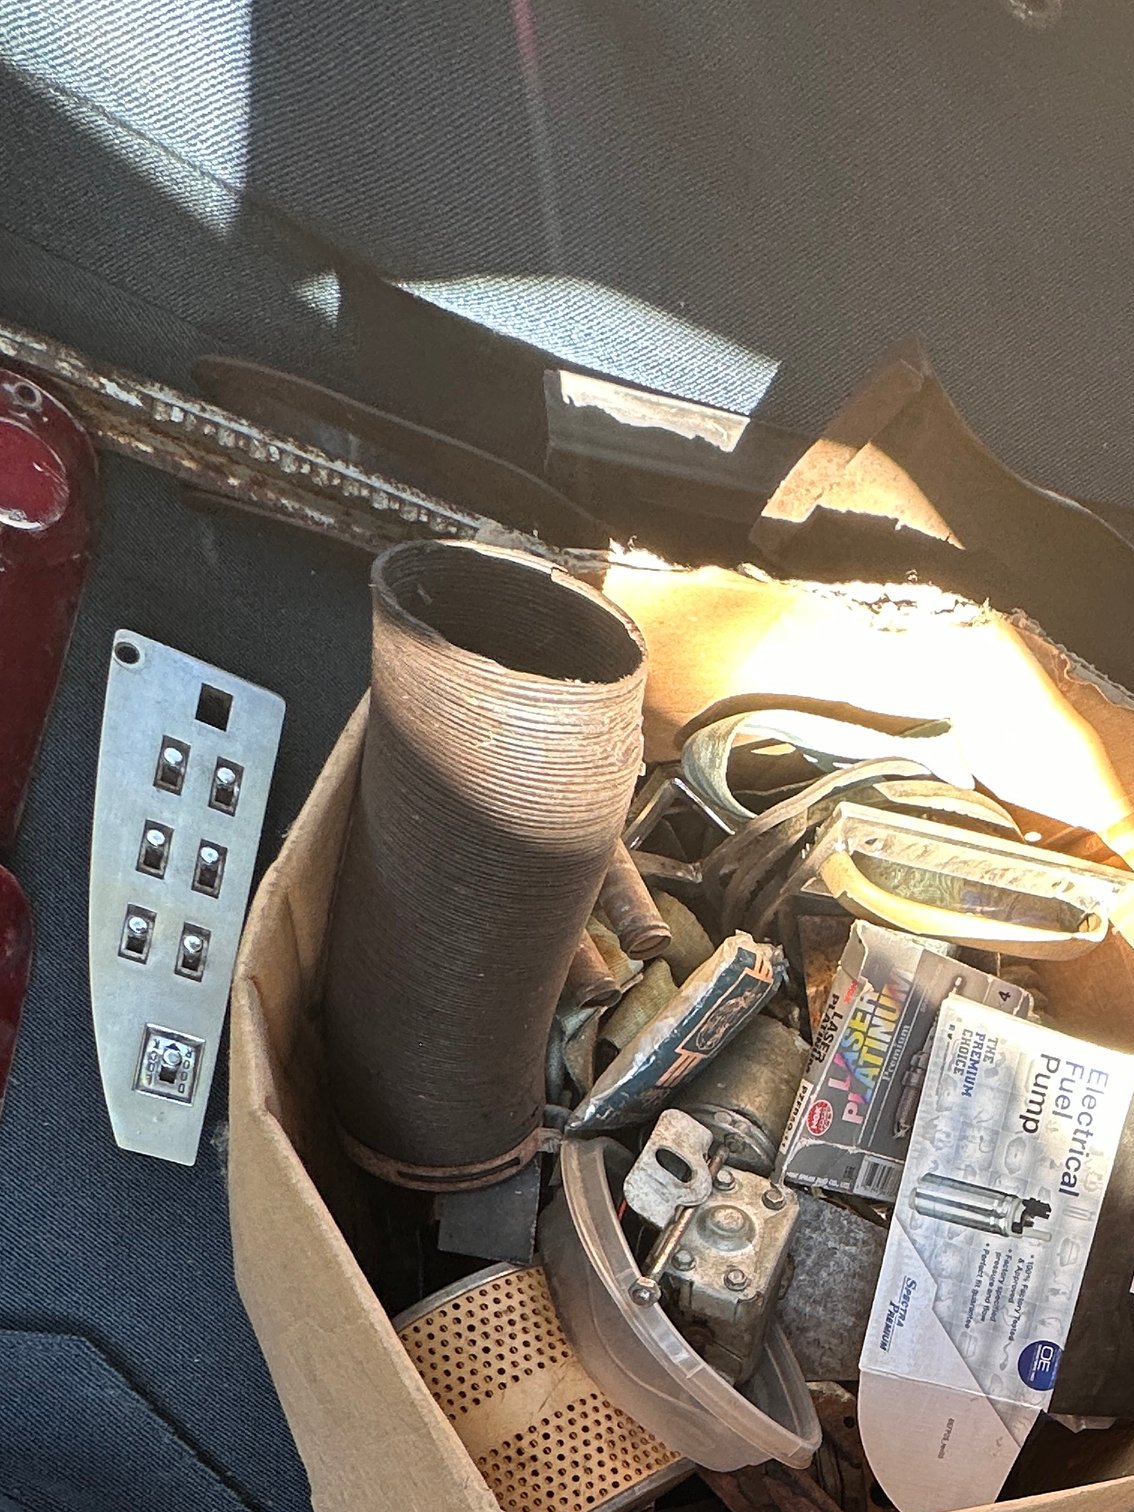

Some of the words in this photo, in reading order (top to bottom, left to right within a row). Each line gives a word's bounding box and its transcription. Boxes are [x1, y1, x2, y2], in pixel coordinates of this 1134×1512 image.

[814, 1011, 843, 1064] LASER
[953, 1028, 974, 1077] CHOICE
[961, 1032, 986, 1098] PREMIUM
[983, 1037, 999, 1064] THE
[1019, 1053, 1061, 1134] Pump
[1052, 1061, 1085, 1120] Fuel
[1058, 1067, 1109, 1198] Electrical
